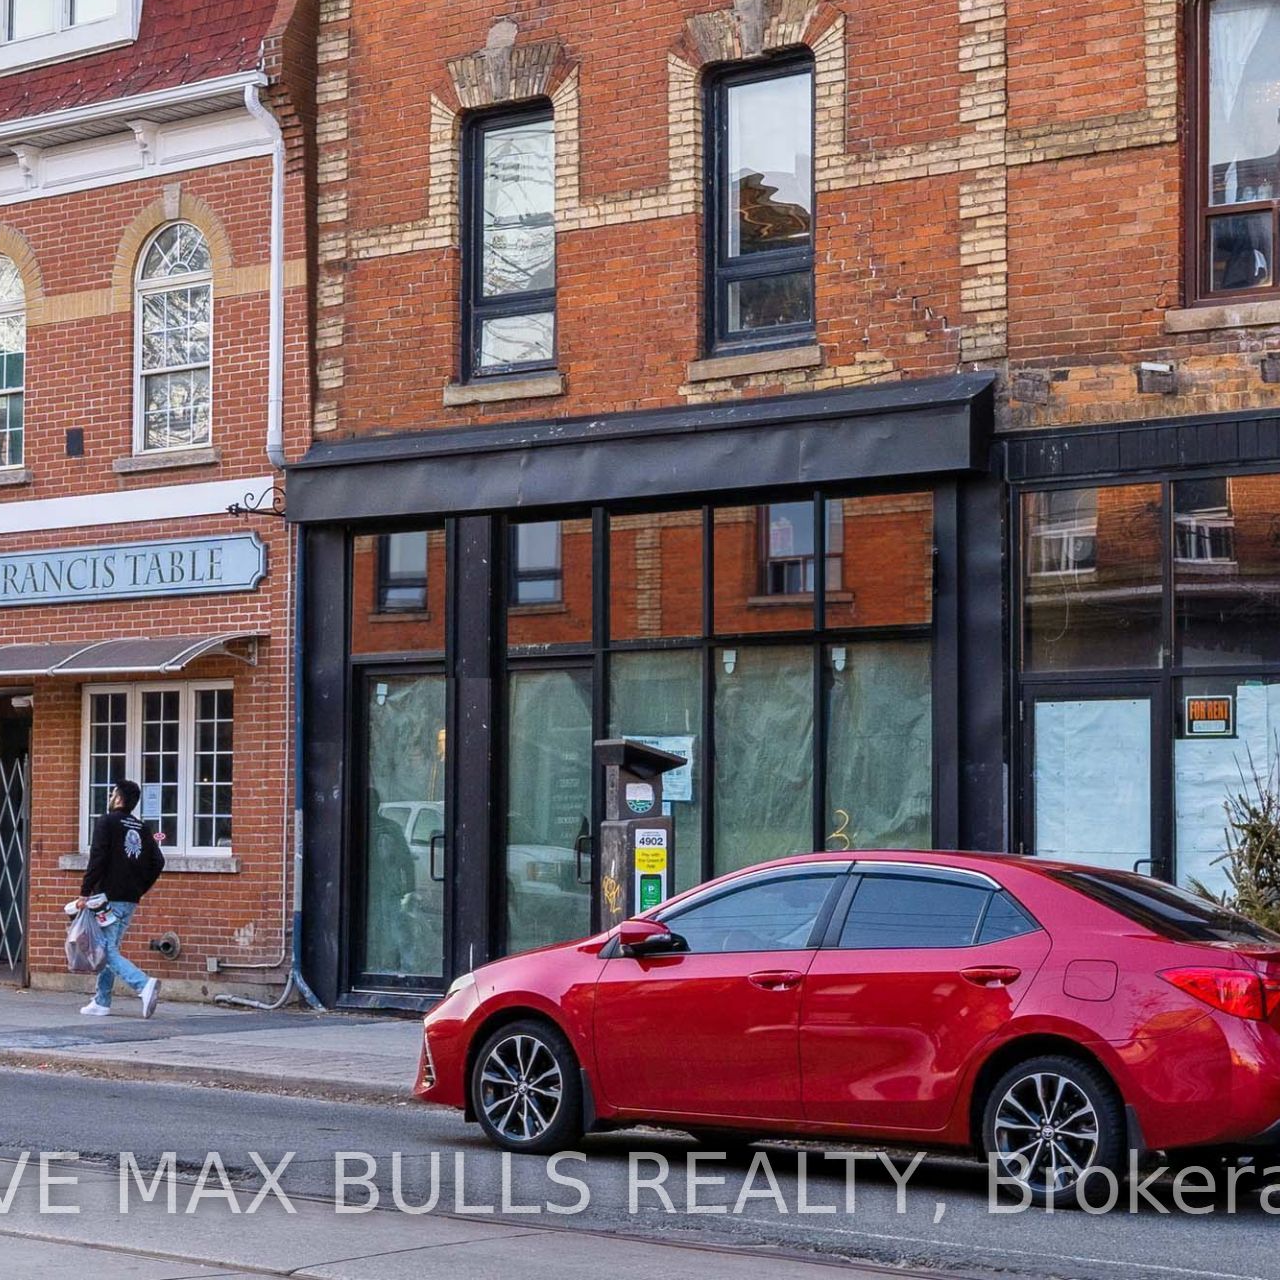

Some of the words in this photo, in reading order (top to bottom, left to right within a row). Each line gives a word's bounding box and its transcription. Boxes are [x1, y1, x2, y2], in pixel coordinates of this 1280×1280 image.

[125, 547, 224, 586] TABLE
[1189, 700, 1206, 720] FOR
[1207, 700, 1228, 720] RENT
[639, 837, 664, 846] 4902
